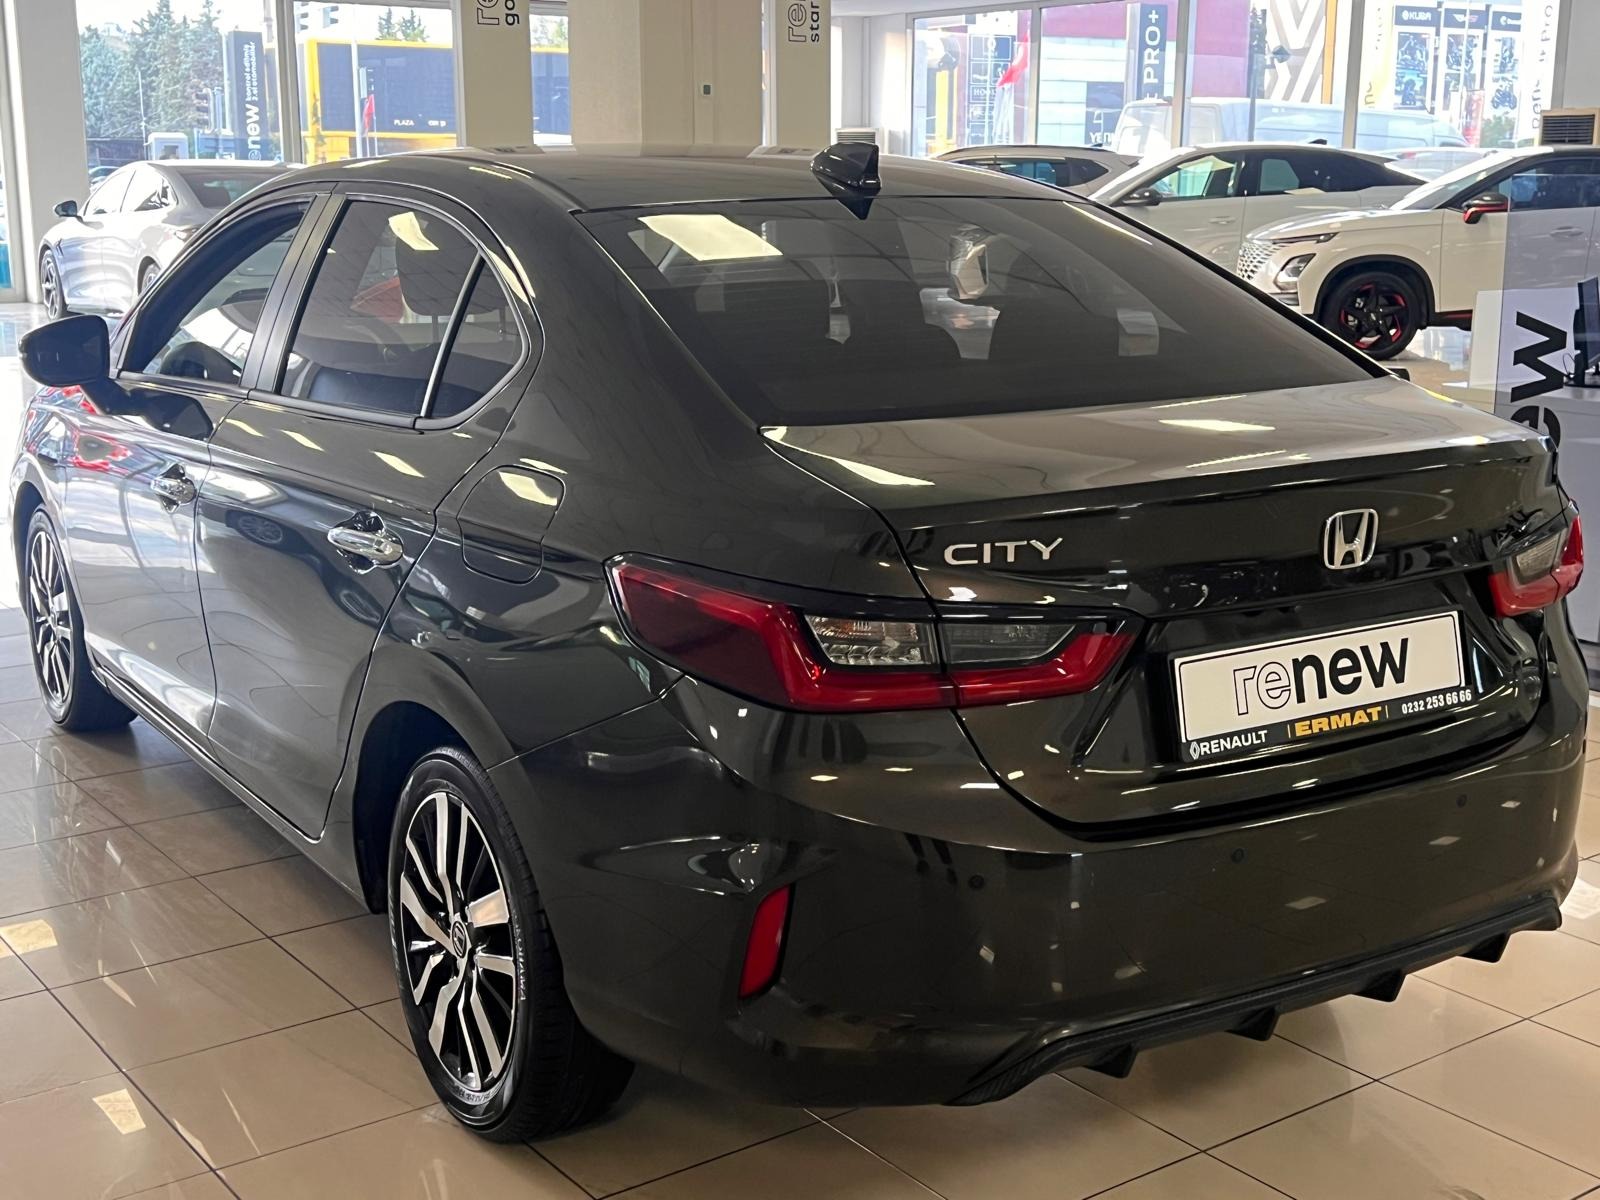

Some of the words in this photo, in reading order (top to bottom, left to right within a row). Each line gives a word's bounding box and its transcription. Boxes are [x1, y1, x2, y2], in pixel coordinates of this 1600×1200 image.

[788, 0, 807, 42] re
[1143, 9, 1160, 84] PRO+
[944, 536, 1064, 566] CITY
[1233, 637, 1409, 716] renew
[1199, 729, 1268, 756] RENAULT
[1294, 704, 1383, 738] ERMAT
[1401, 699, 1426, 715] 0232
[1426, 693, 1445, 709] 253
